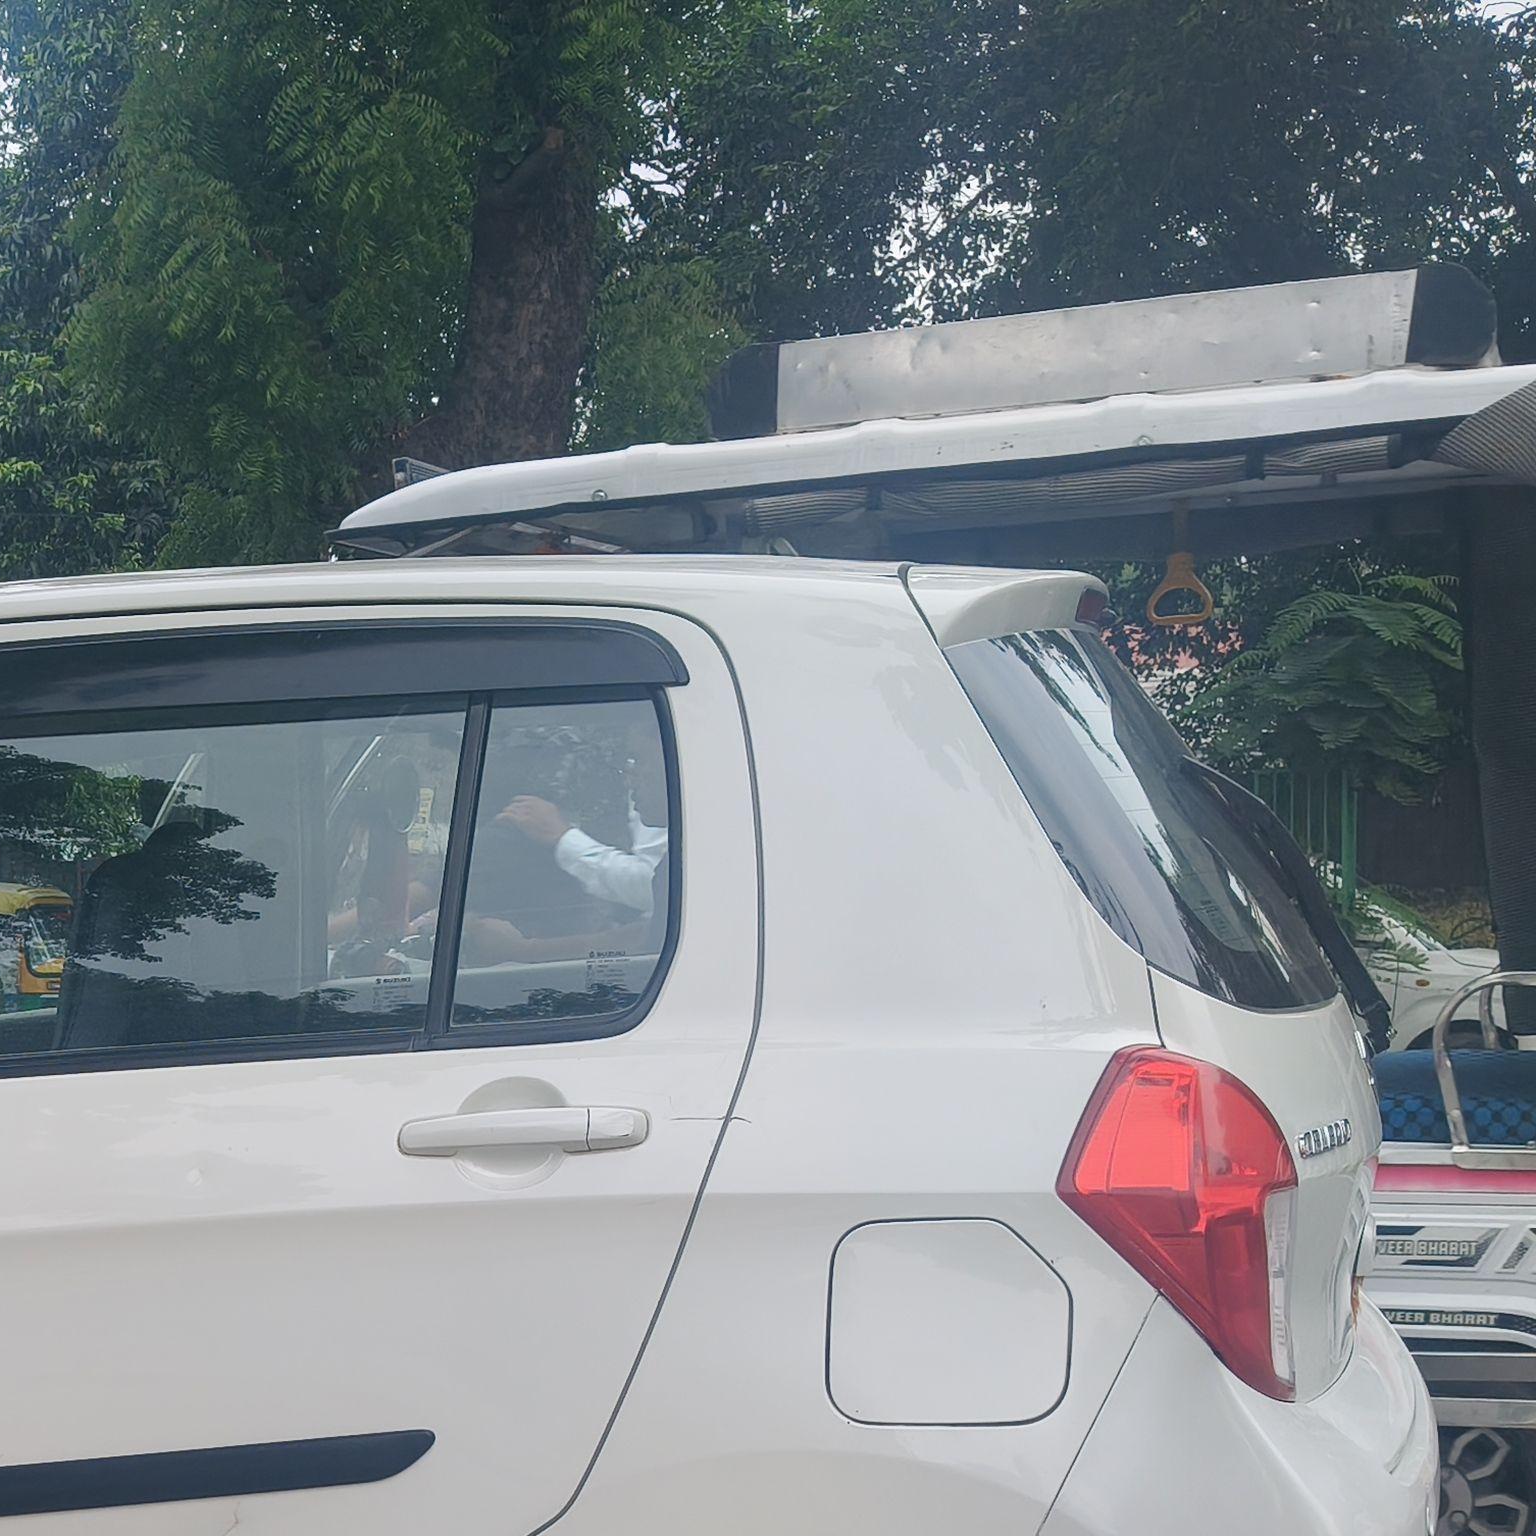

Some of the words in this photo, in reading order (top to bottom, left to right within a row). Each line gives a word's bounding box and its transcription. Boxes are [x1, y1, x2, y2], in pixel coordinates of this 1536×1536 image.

[1376, 1239, 1414, 1255] VEER
[1415, 1240, 1479, 1256] BHARAT
[1385, 1311, 1425, 1323] VEER
[1429, 1312, 1499, 1325] BHARAT
